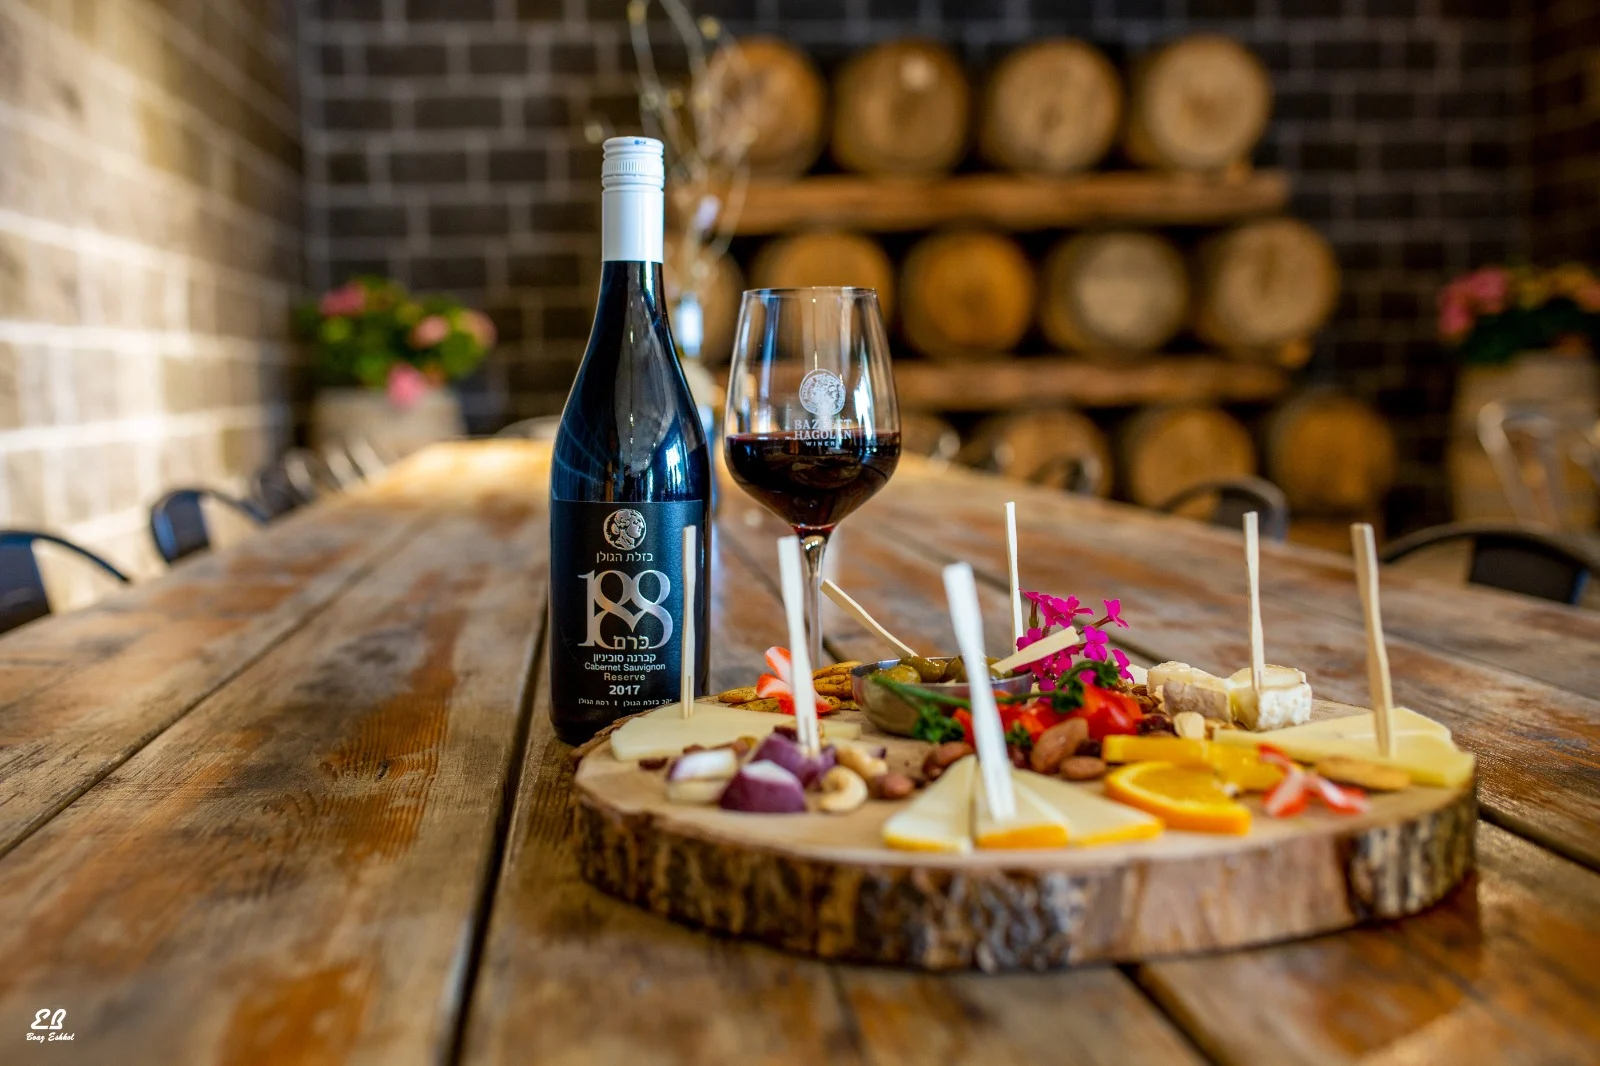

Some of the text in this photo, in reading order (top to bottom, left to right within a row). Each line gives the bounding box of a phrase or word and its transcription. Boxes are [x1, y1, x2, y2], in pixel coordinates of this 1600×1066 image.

[794, 419, 852, 430] BAZET
[793, 429, 852, 440] HAGOLAN
[596, 551, 654, 564] בזלת הגולן
[577, 569, 674, 650] 188
[593, 653, 657, 664] קברנה סוביניון
[584, 662, 666, 673] Cabernet Sauvignon
[603, 672, 646, 681] Reserve
[608, 684, 641, 695] 2017
